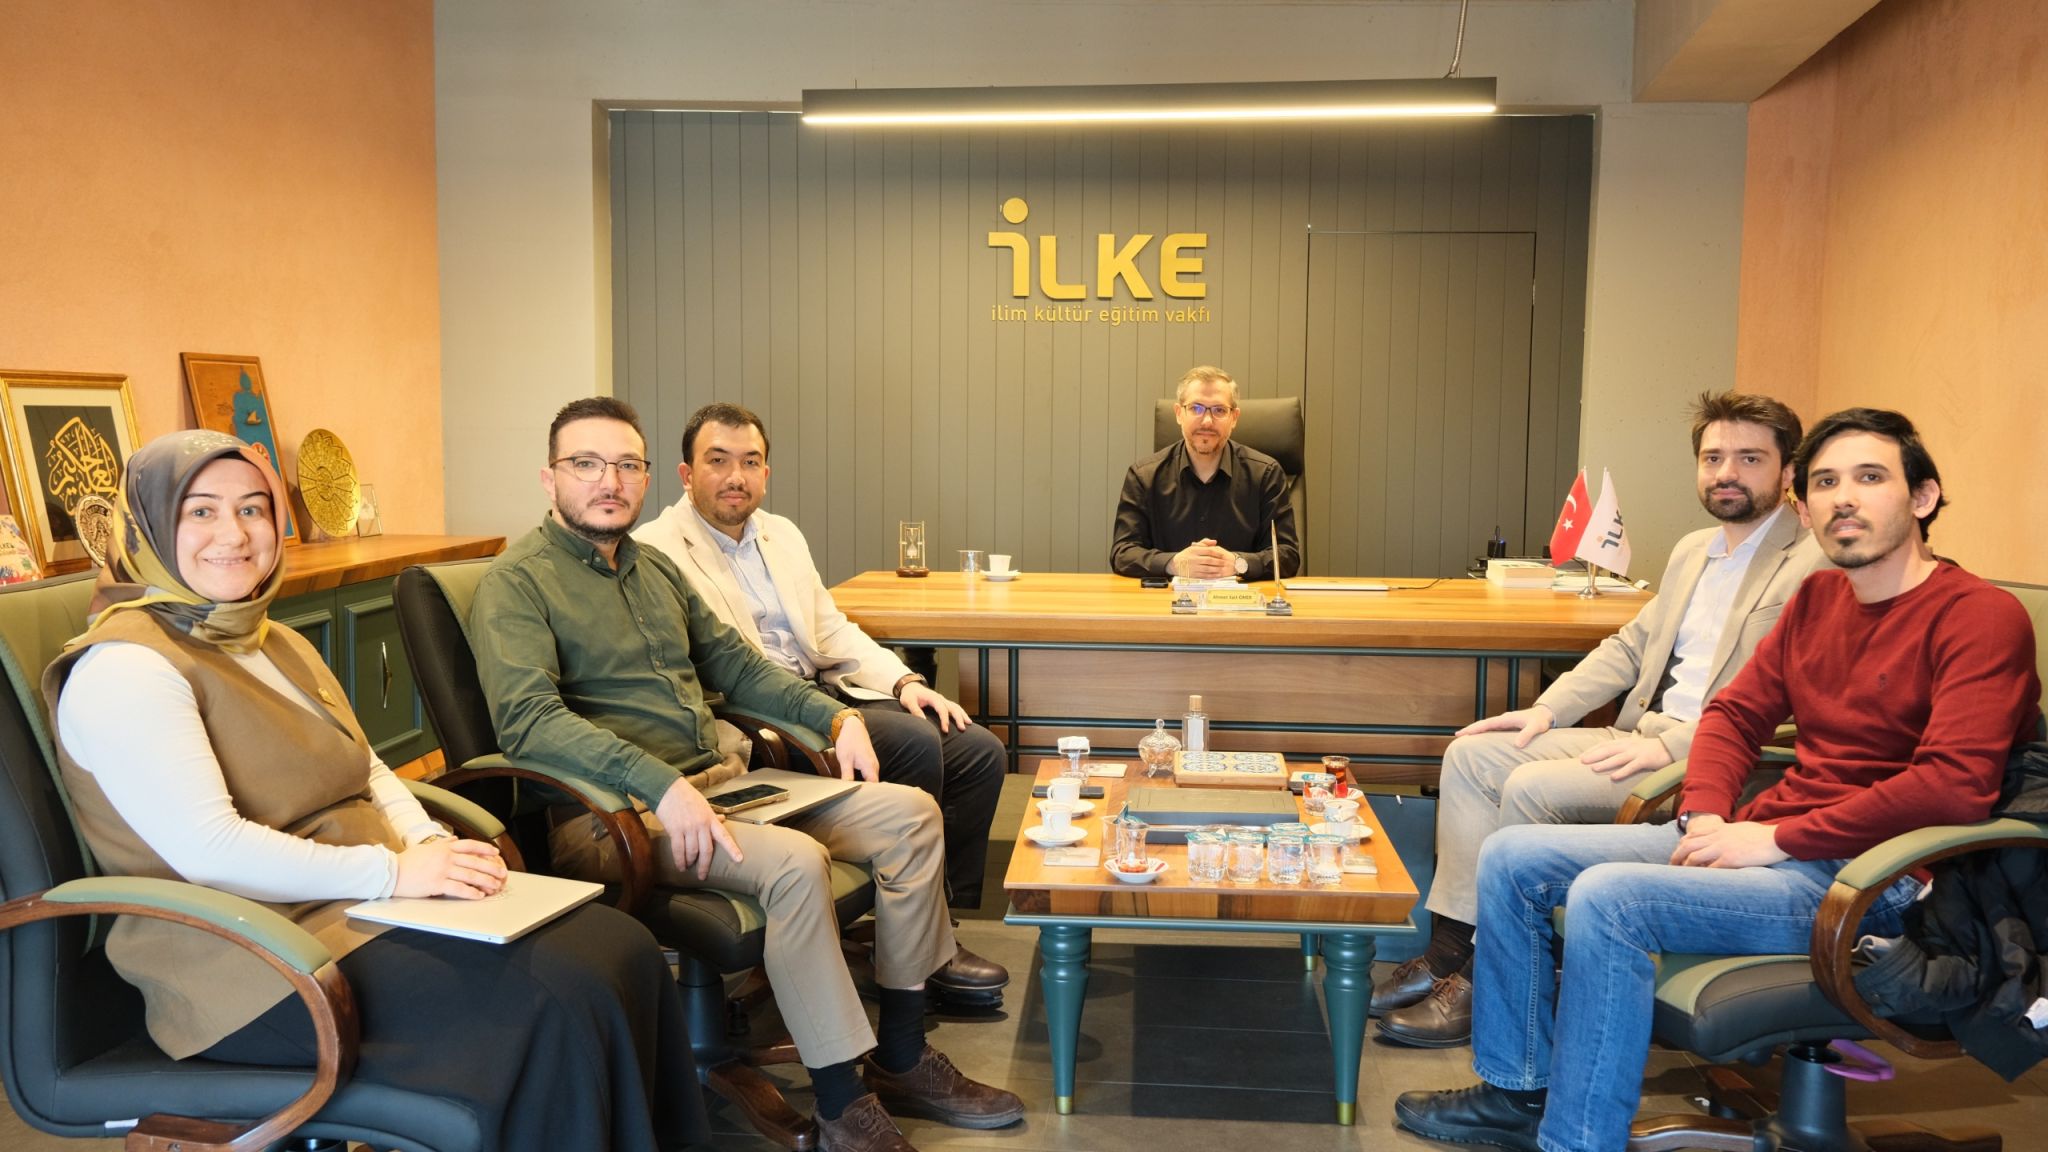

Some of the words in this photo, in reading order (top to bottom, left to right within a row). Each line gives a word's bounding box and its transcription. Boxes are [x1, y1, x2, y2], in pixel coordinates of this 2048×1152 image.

[991, 305, 1027, 321] ilim
[1034, 305, 1092, 321] kültür
[1099, 306, 1159, 326] eğitim
[1165, 306, 1211, 322] vakfı
